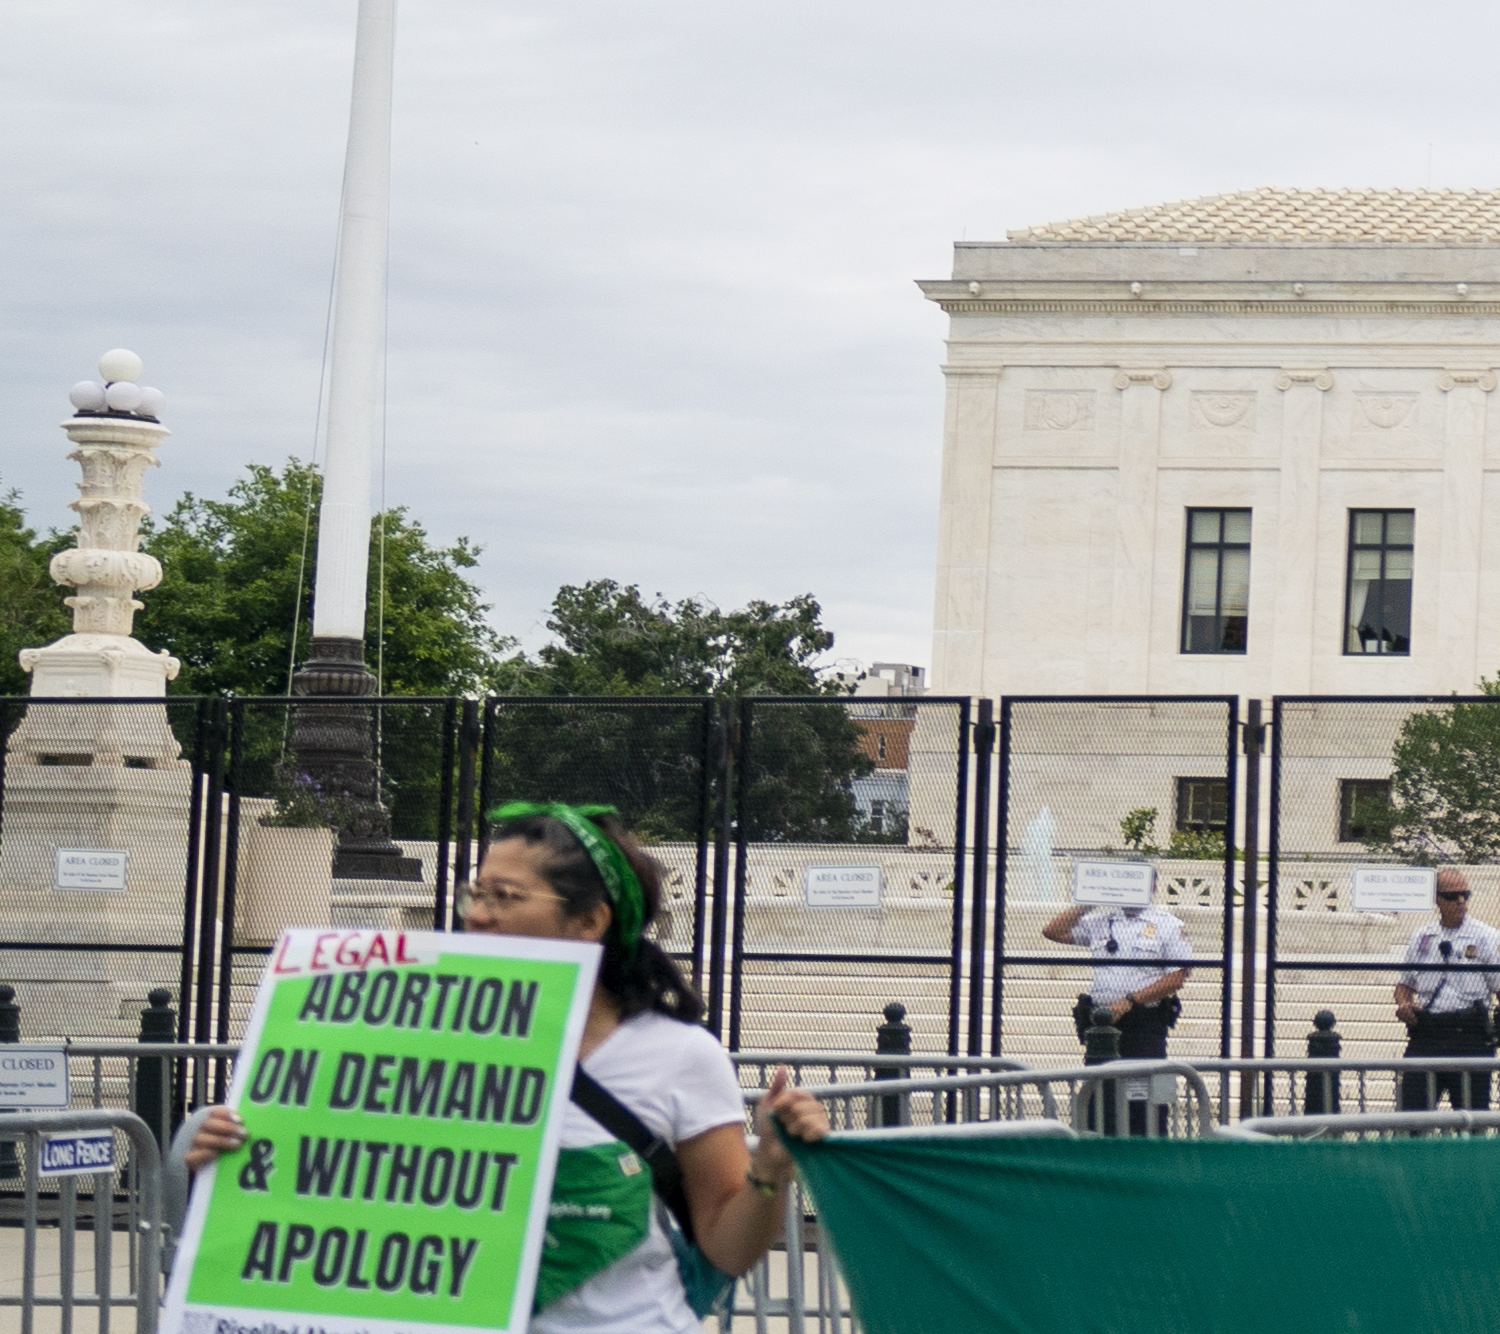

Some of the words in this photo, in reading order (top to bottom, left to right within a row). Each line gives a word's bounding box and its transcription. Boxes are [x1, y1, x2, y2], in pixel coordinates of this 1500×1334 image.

[273, 933, 420, 975] LEGAL
[298, 971, 540, 1041] ABORTION
[2, 1058, 55, 1070] CLOSED
[250, 1047, 317, 1108] ON
[329, 1051, 547, 1128] DEMAND
[44, 1141, 75, 1168] LONG
[76, 1138, 111, 1165] FENCE
[239, 1137, 275, 1192] &
[294, 1136, 519, 1213] WITHOUT
[242, 1221, 480, 1299] APOLOGY
